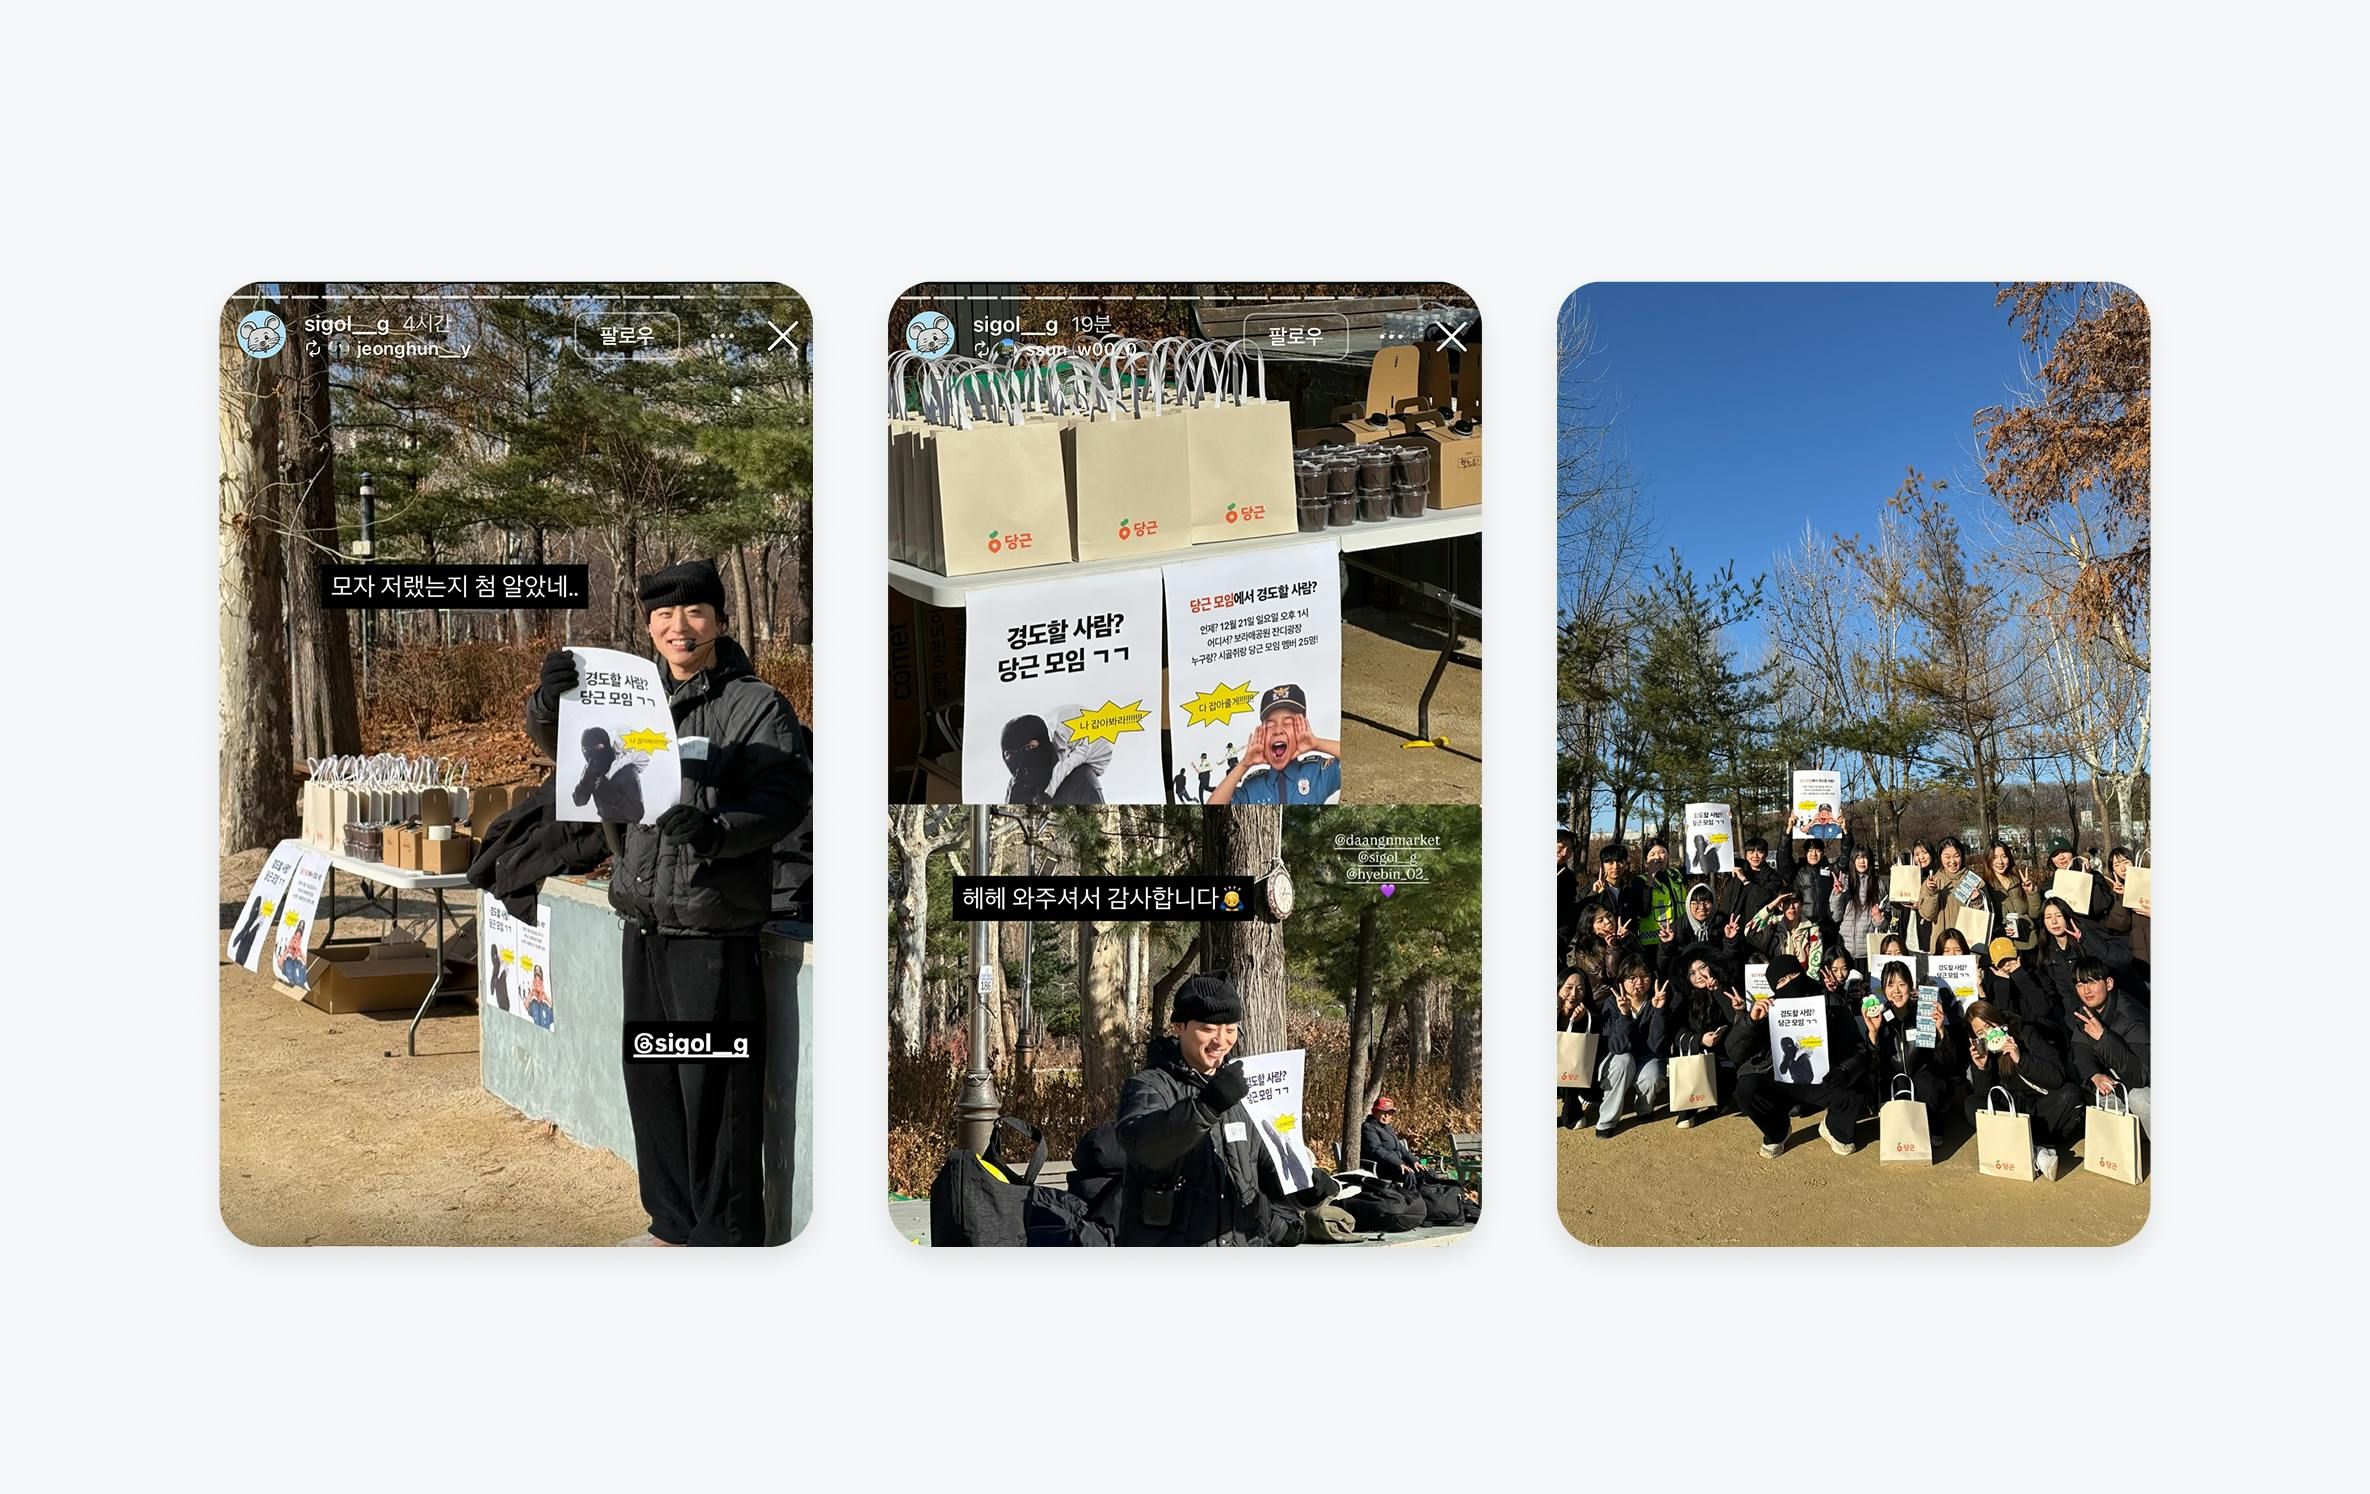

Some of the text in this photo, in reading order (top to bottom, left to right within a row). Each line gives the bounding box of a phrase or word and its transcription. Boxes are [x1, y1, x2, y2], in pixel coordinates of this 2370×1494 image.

[1241, 505, 1266, 521] 당근
[1134, 520, 1159, 537] 당근
[1005, 532, 1033, 550] 당근
[1190, 581, 1318, 613] 당근 모임에서 경도할 사람?
[1200, 608, 1309, 635] 언제? 12월 21일 일요일 오후 1시
[1007, 612, 1125, 650] 경도할 사람?
[1207, 635, 1233, 647] 어디서?
[1272, 623, 1302, 637] 잔디광장
[1191, 635, 1319, 666] 누구랑? 시골쥐랑 당근 모임 멤버 25명!
[998, 647, 1130, 683] 당근 모임 ㄱㄱ
[586, 672, 649, 691] 경도할 사람?
[580, 690, 656, 707] 당근 모임 ㄱㄱ
[1199, 703, 1207, 712] 다
[1080, 720, 1089, 730] 나
[1267, 1070, 1287, 1084] 사람?
[1259, 1088, 1273, 1101] 모임
